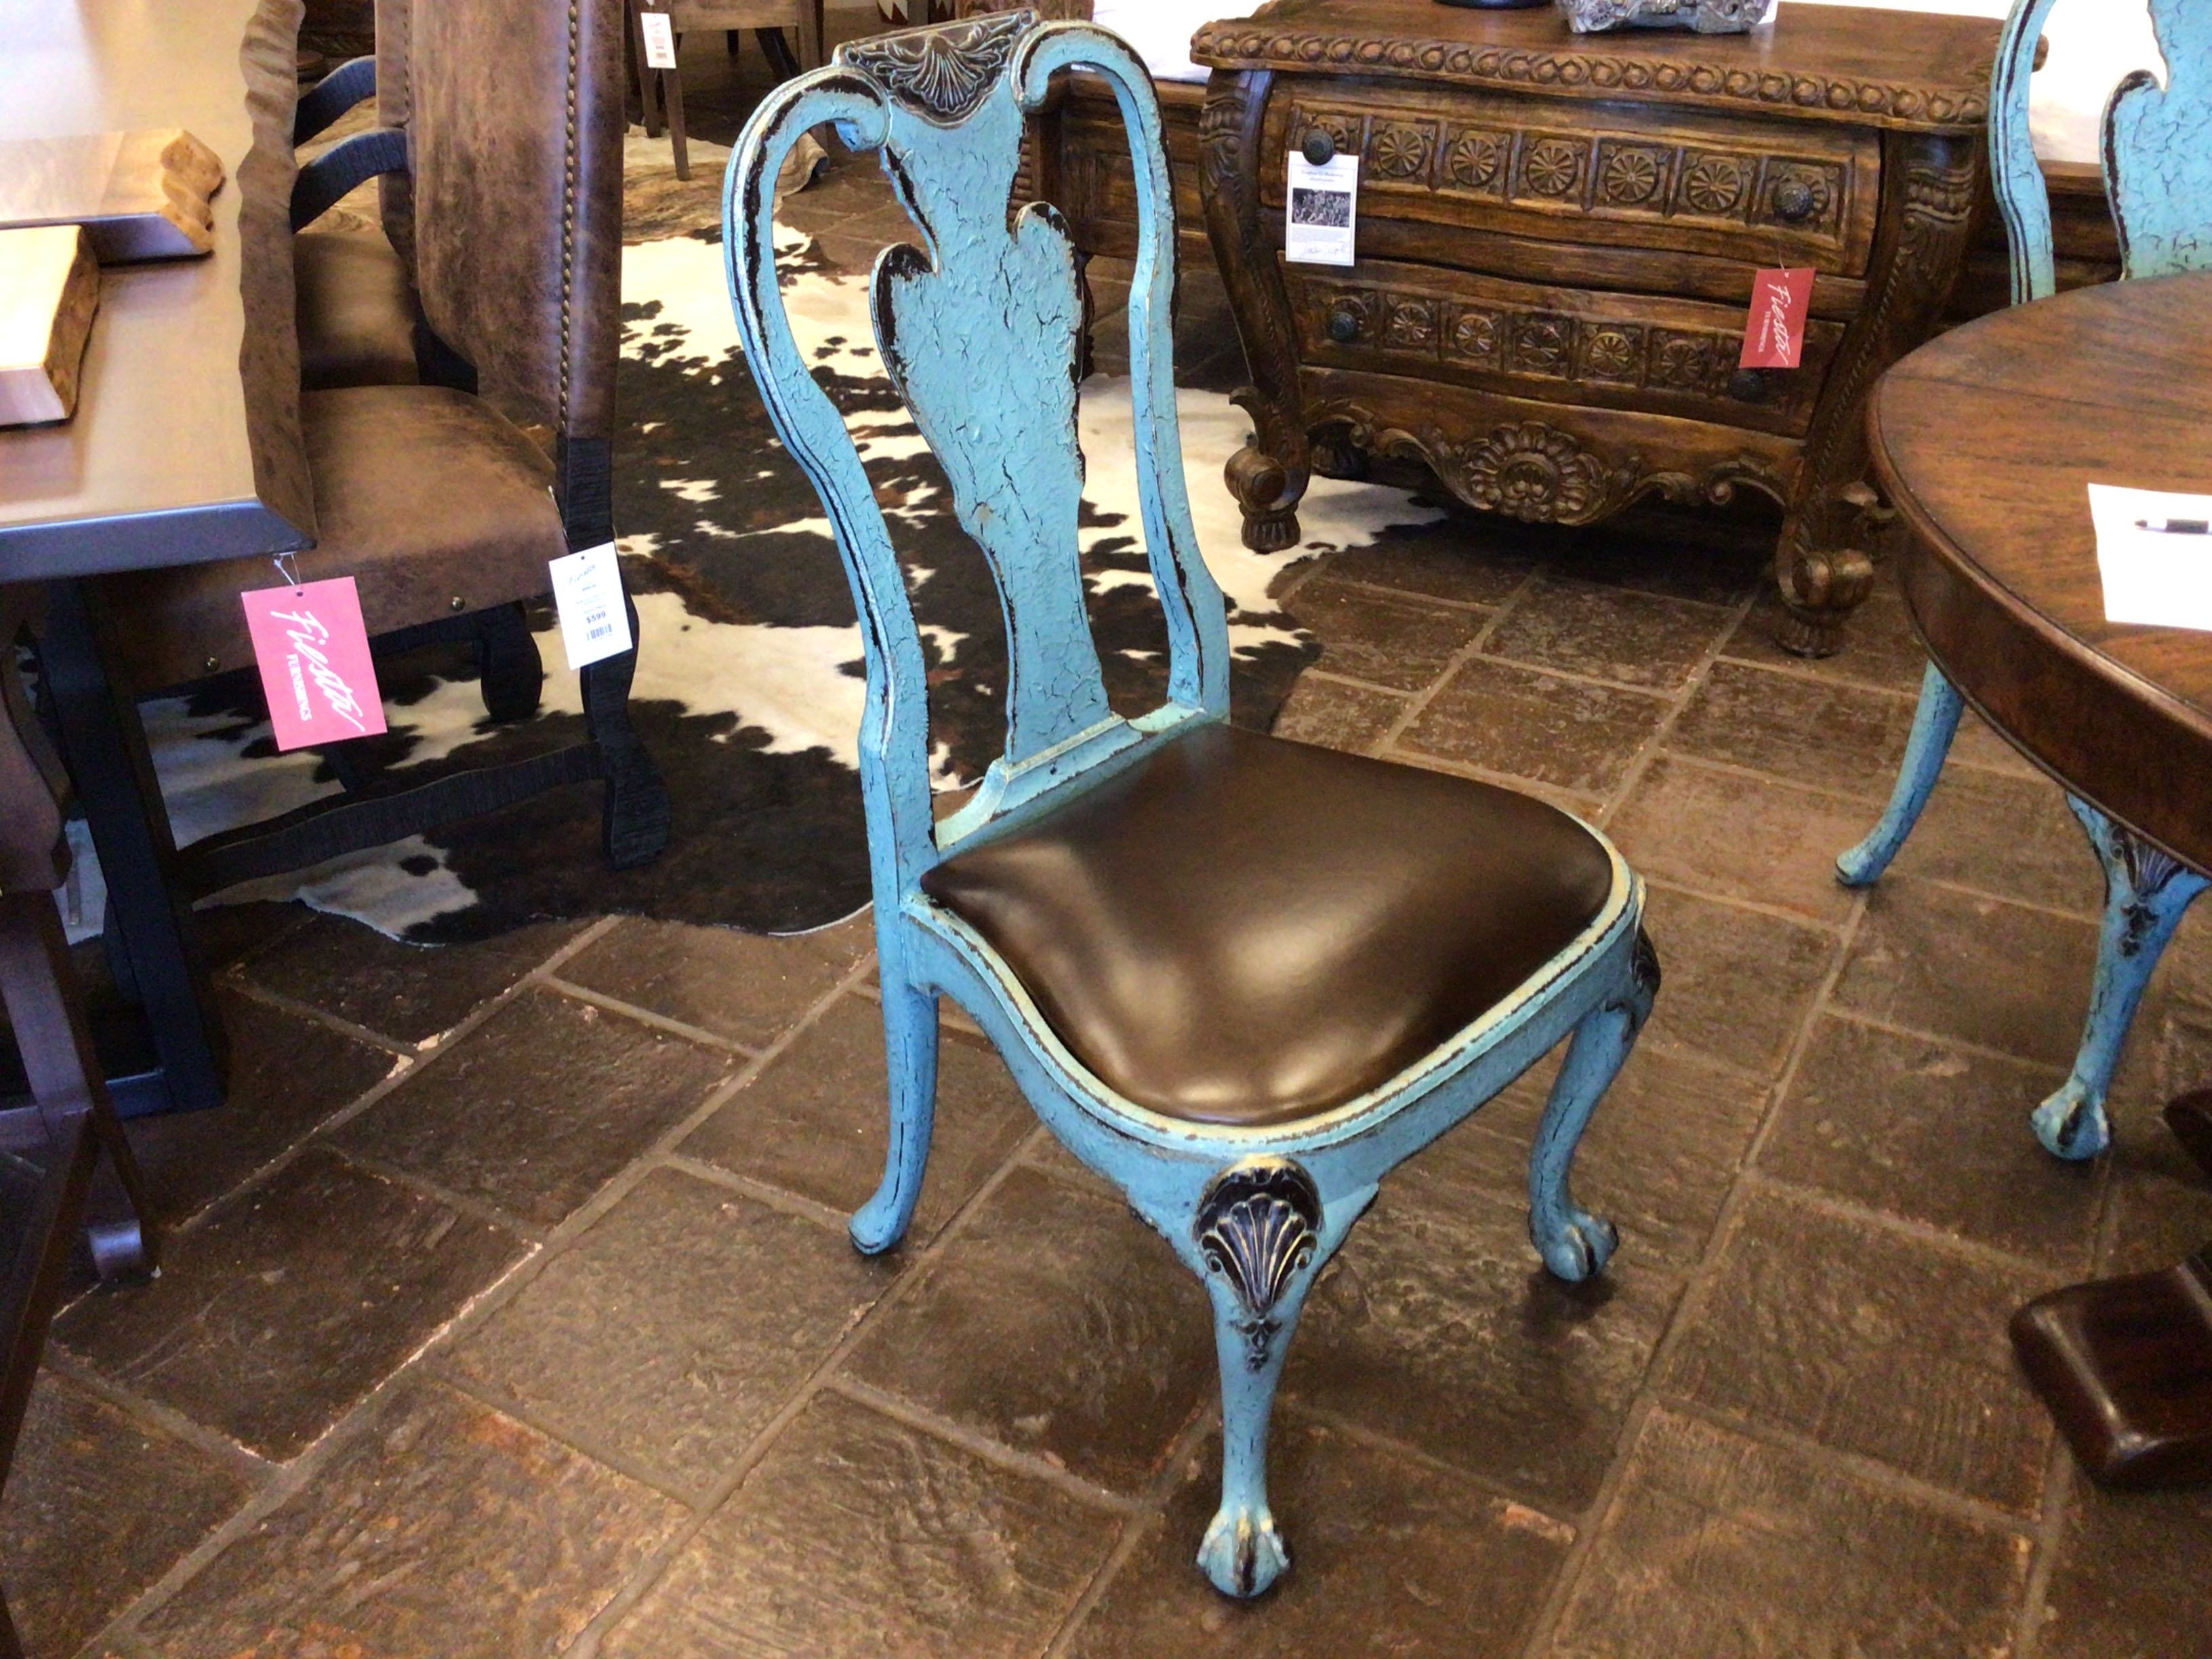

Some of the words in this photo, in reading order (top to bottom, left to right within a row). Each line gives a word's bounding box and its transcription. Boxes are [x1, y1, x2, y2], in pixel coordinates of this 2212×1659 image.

[1767, 283, 1791, 365] Fiesta
[586, 611, 607, 624] $599
[270, 611, 365, 733] Fiesta
